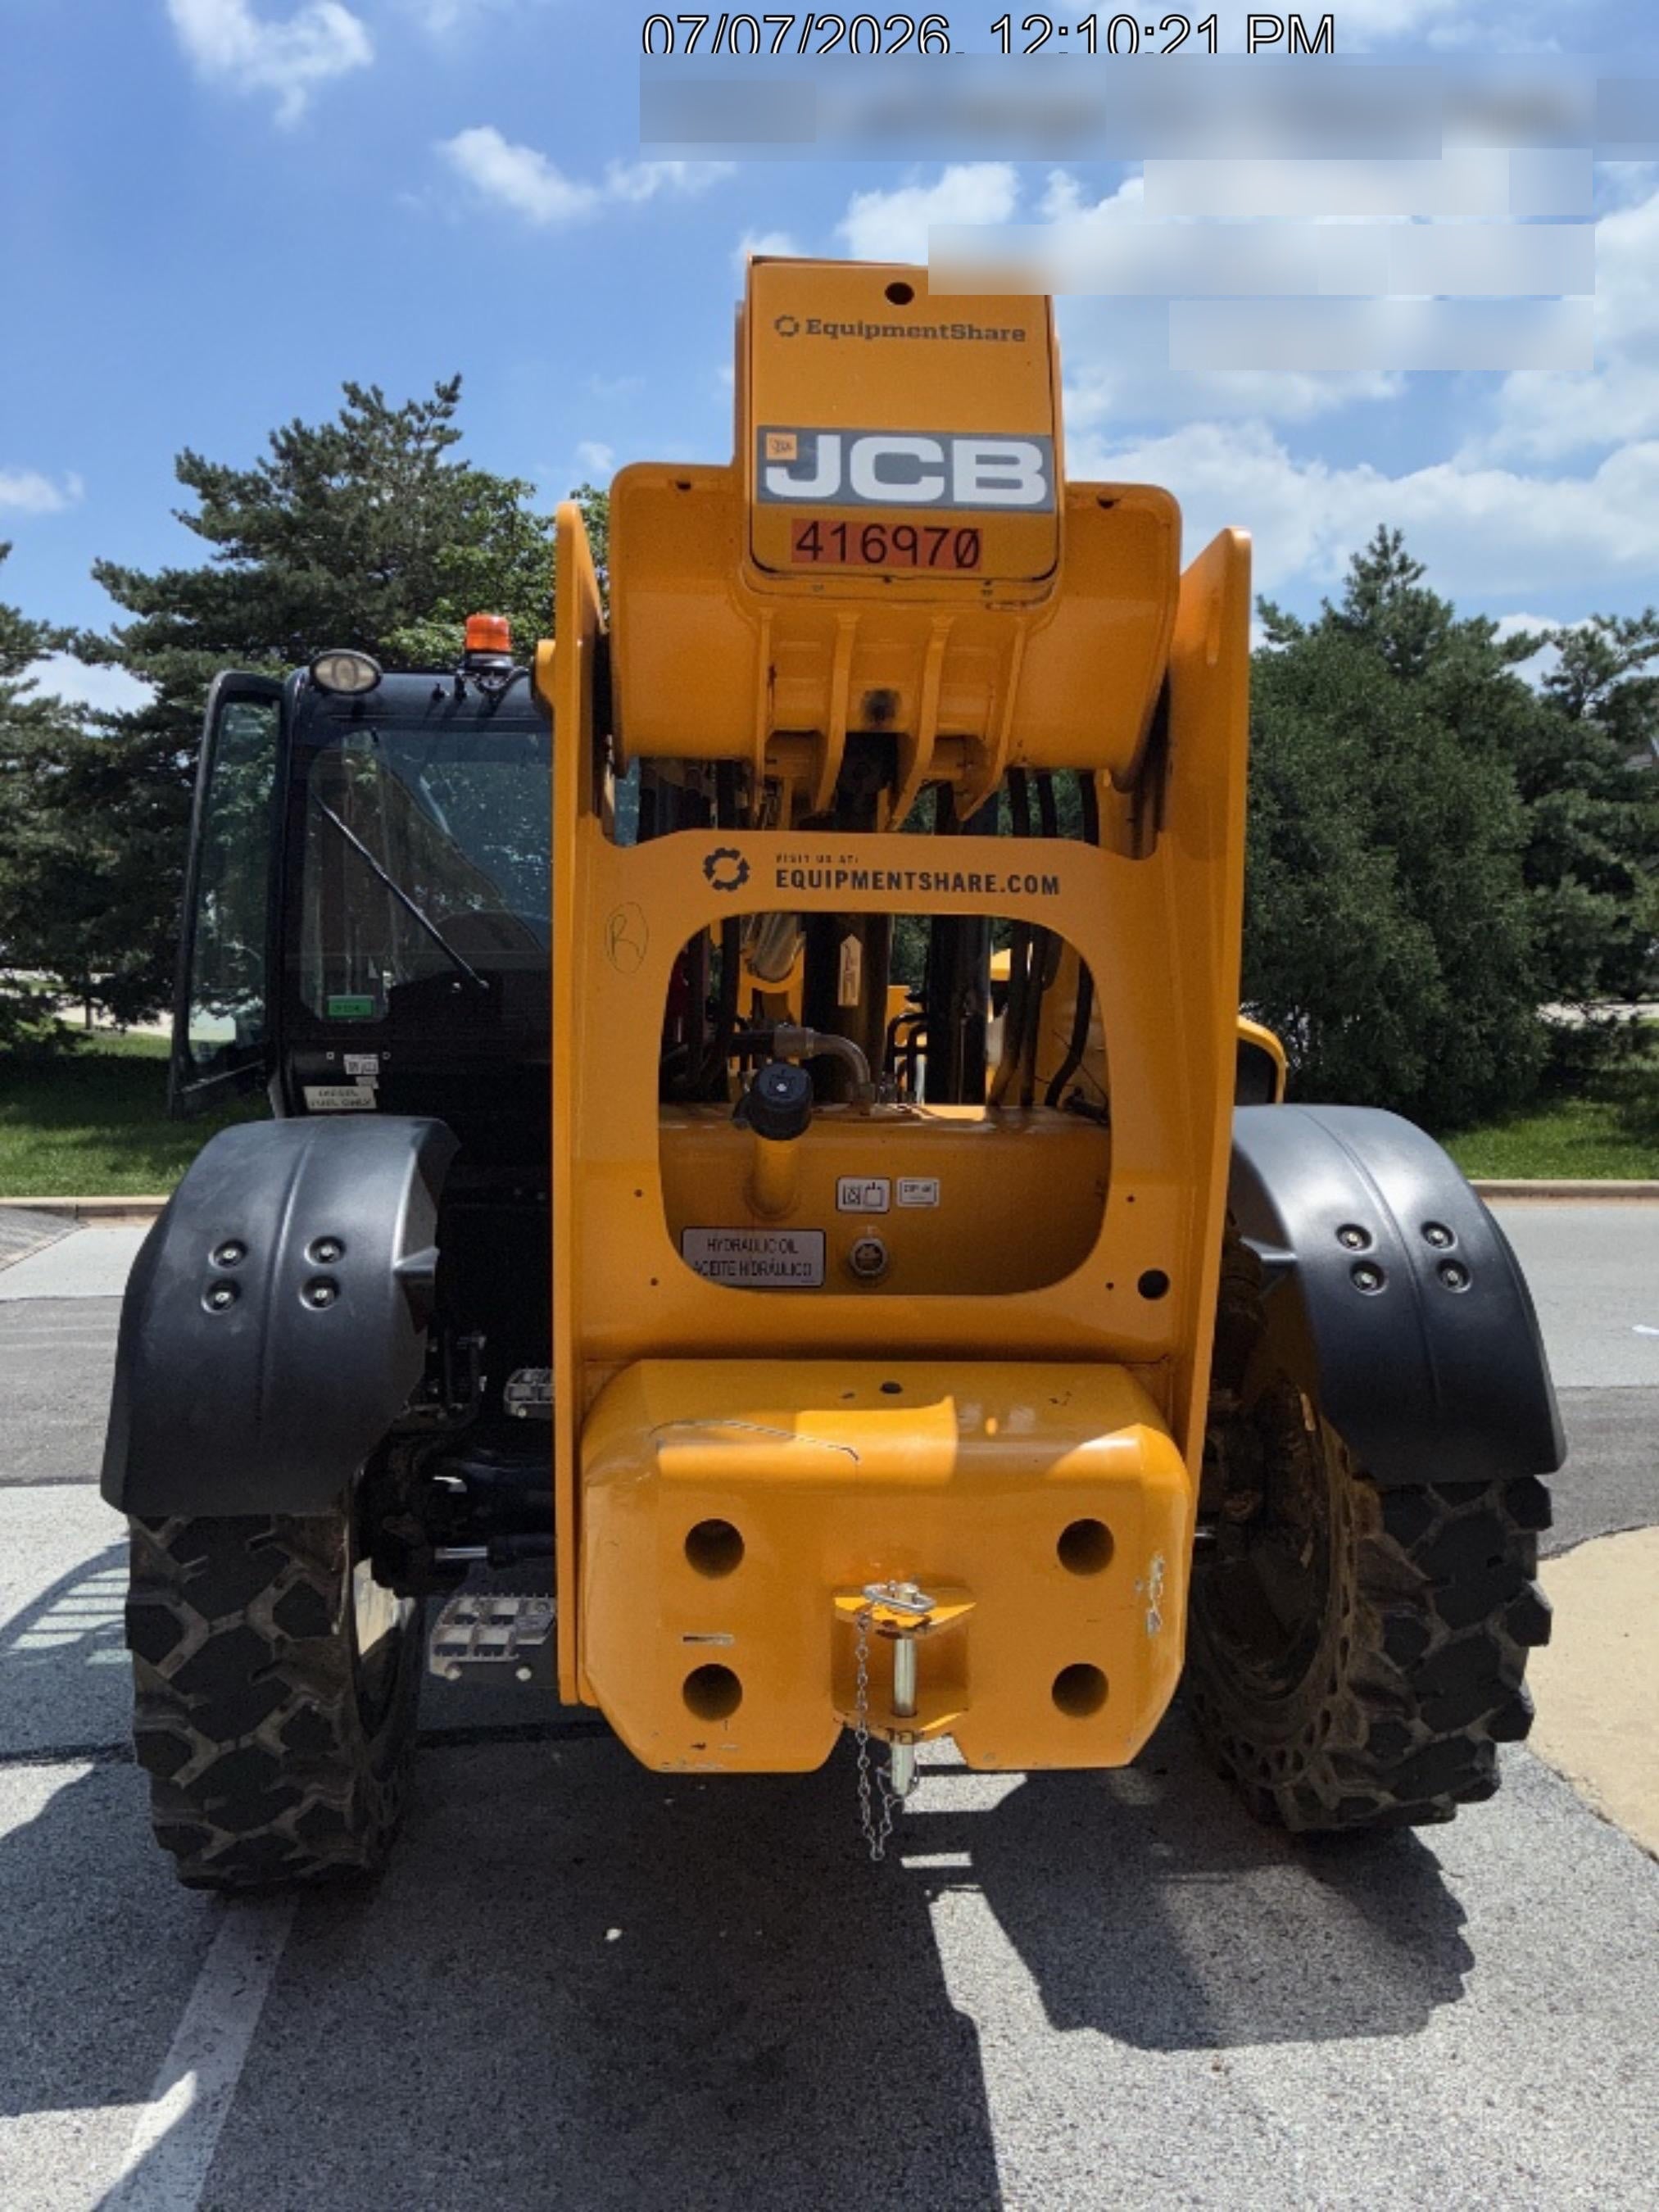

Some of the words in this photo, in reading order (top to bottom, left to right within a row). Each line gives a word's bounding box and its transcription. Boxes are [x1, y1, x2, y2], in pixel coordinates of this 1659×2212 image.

[806, 319, 1027, 342] EquipmentShare
[765, 434, 1048, 505] JCB
[796, 521, 981, 569] 416970
[776, 854, 809, 863] VISIT
[816, 854, 832, 863] US
[776, 868, 1060, 895] EQUIPMENTSHARE.COM
[707, 1238, 777, 1253] HYDRAULIC
[779, 1239, 800, 1254] OIL
